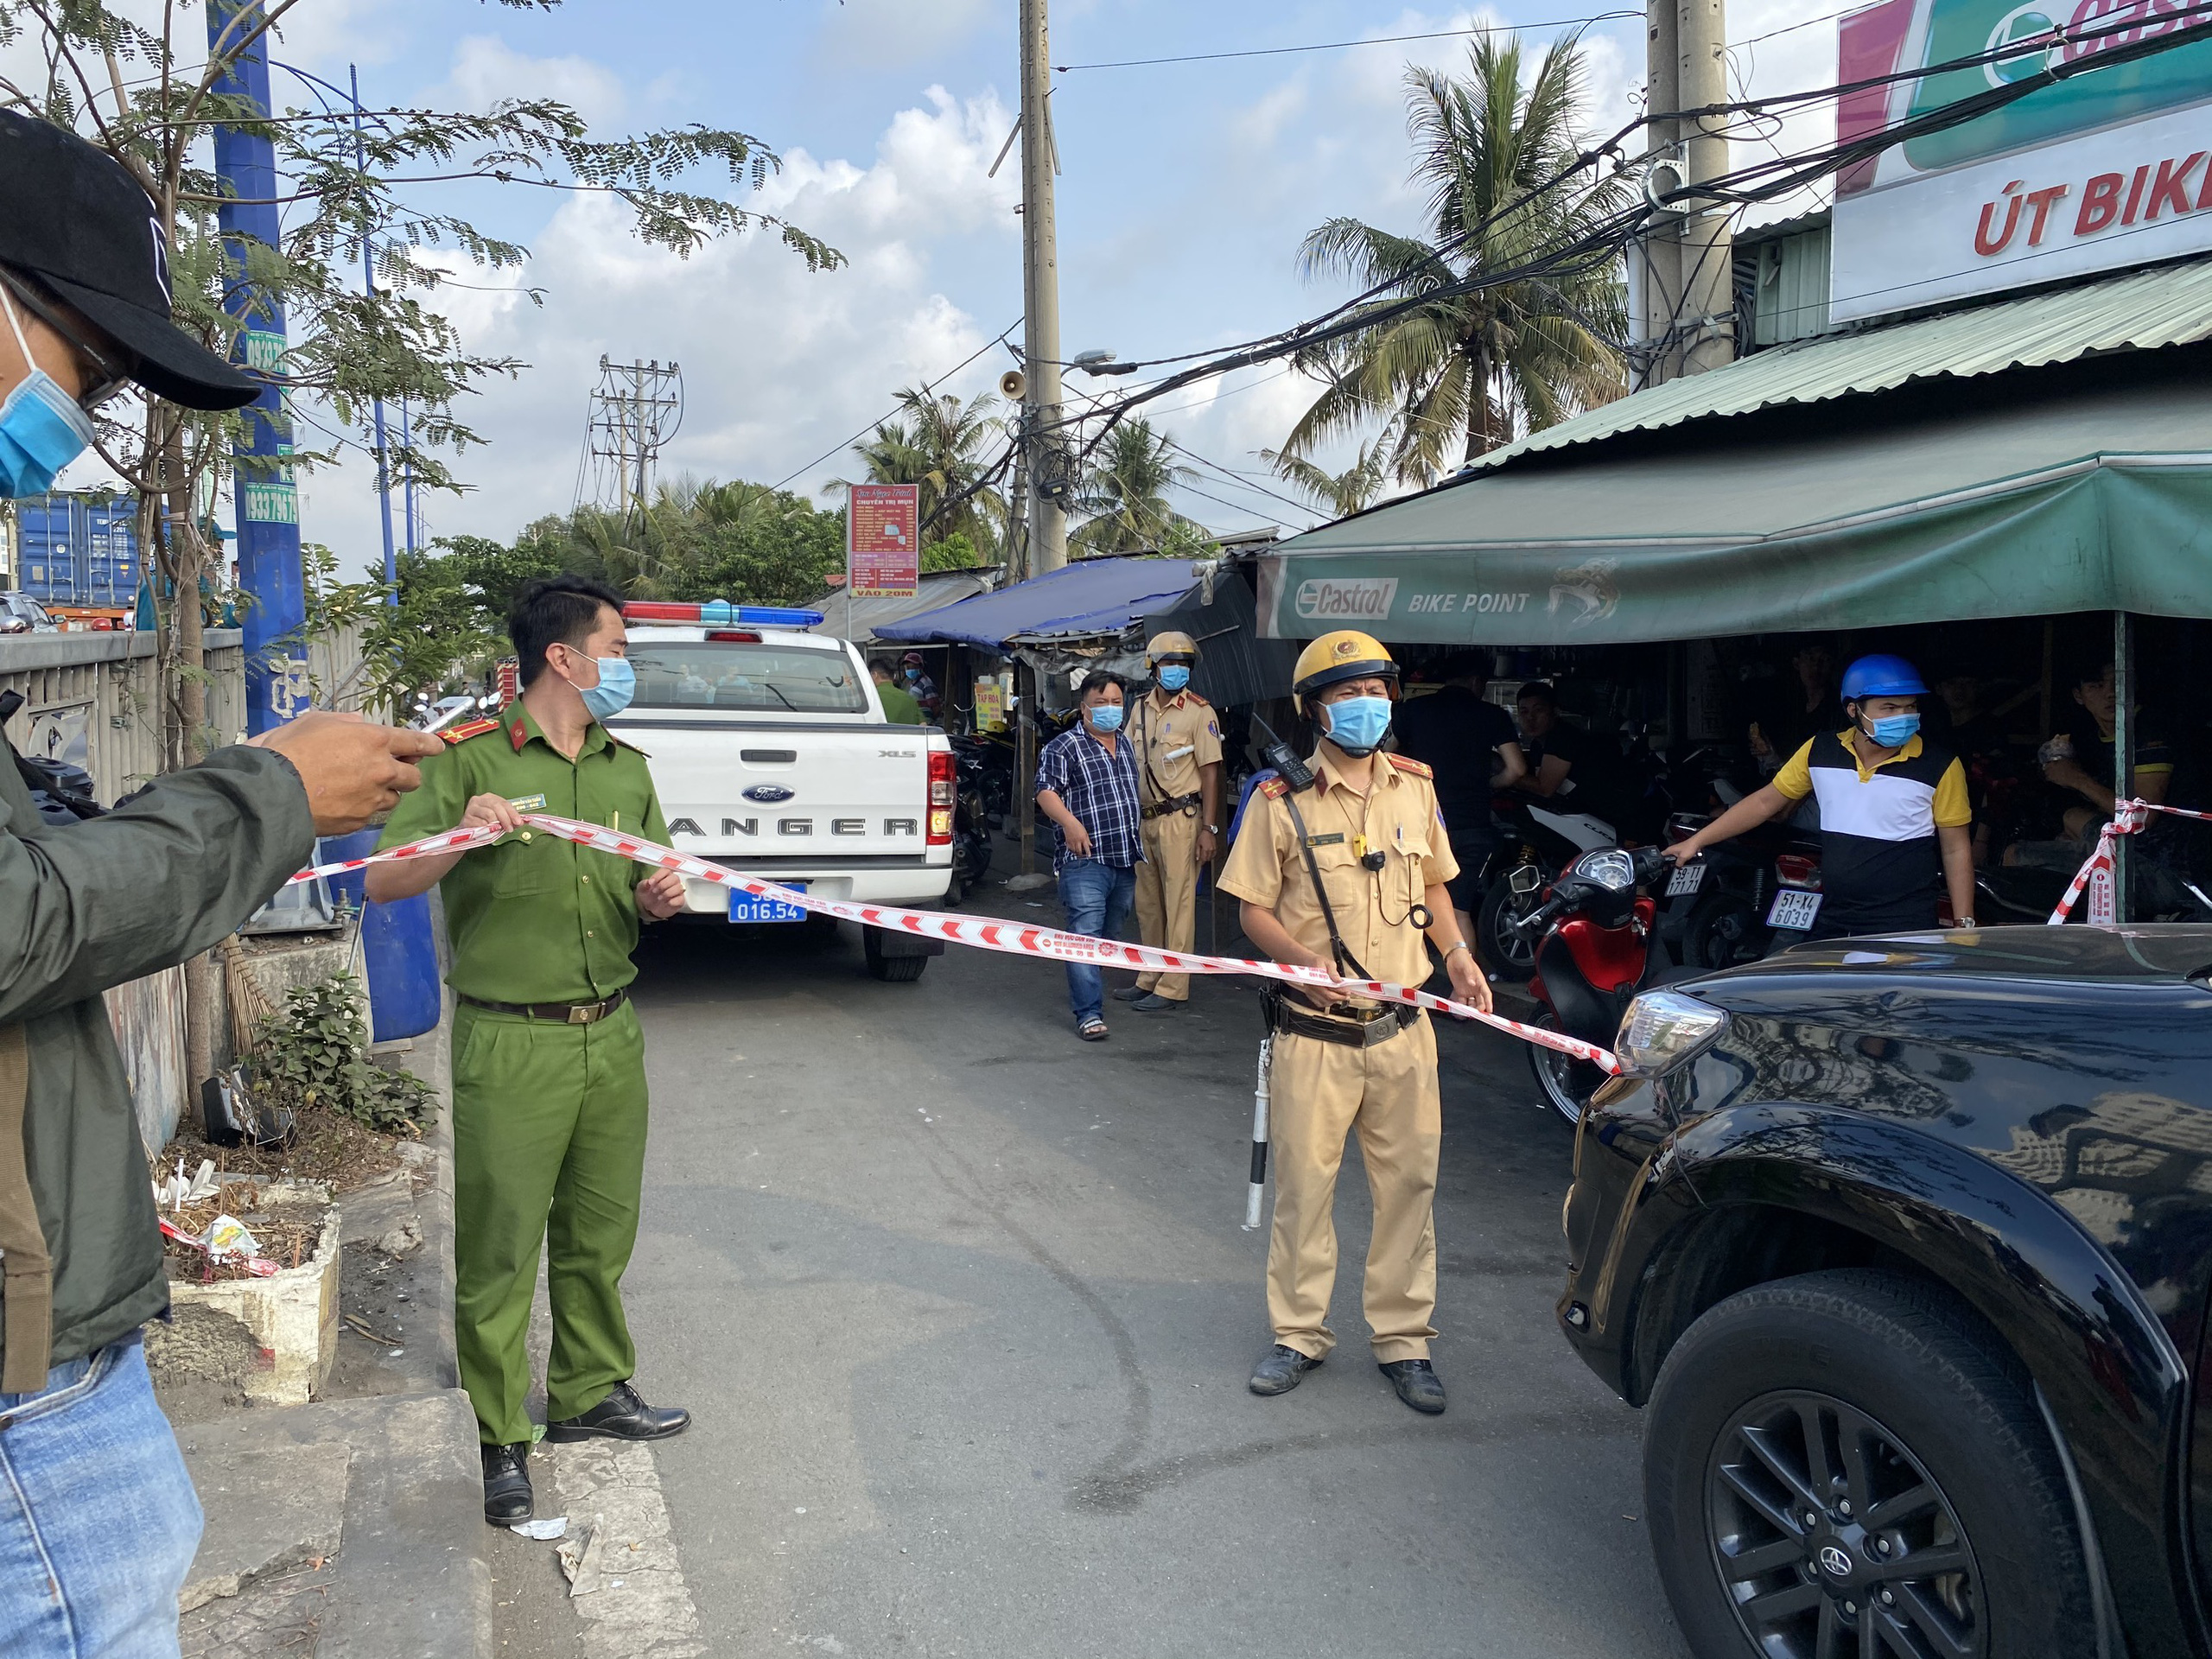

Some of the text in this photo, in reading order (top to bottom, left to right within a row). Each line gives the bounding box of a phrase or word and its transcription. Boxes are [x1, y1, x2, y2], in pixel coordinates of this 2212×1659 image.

[1974, 150, 2212, 257] ÚT BIK
[1318, 583, 1530, 613] Castrol BIKE POINT
[754, 786, 783, 799] Ford
[1583, 823, 1615, 843] CLICK
[737, 904, 798, 920] 016.54
[1775, 909, 1810, 927] 6039
